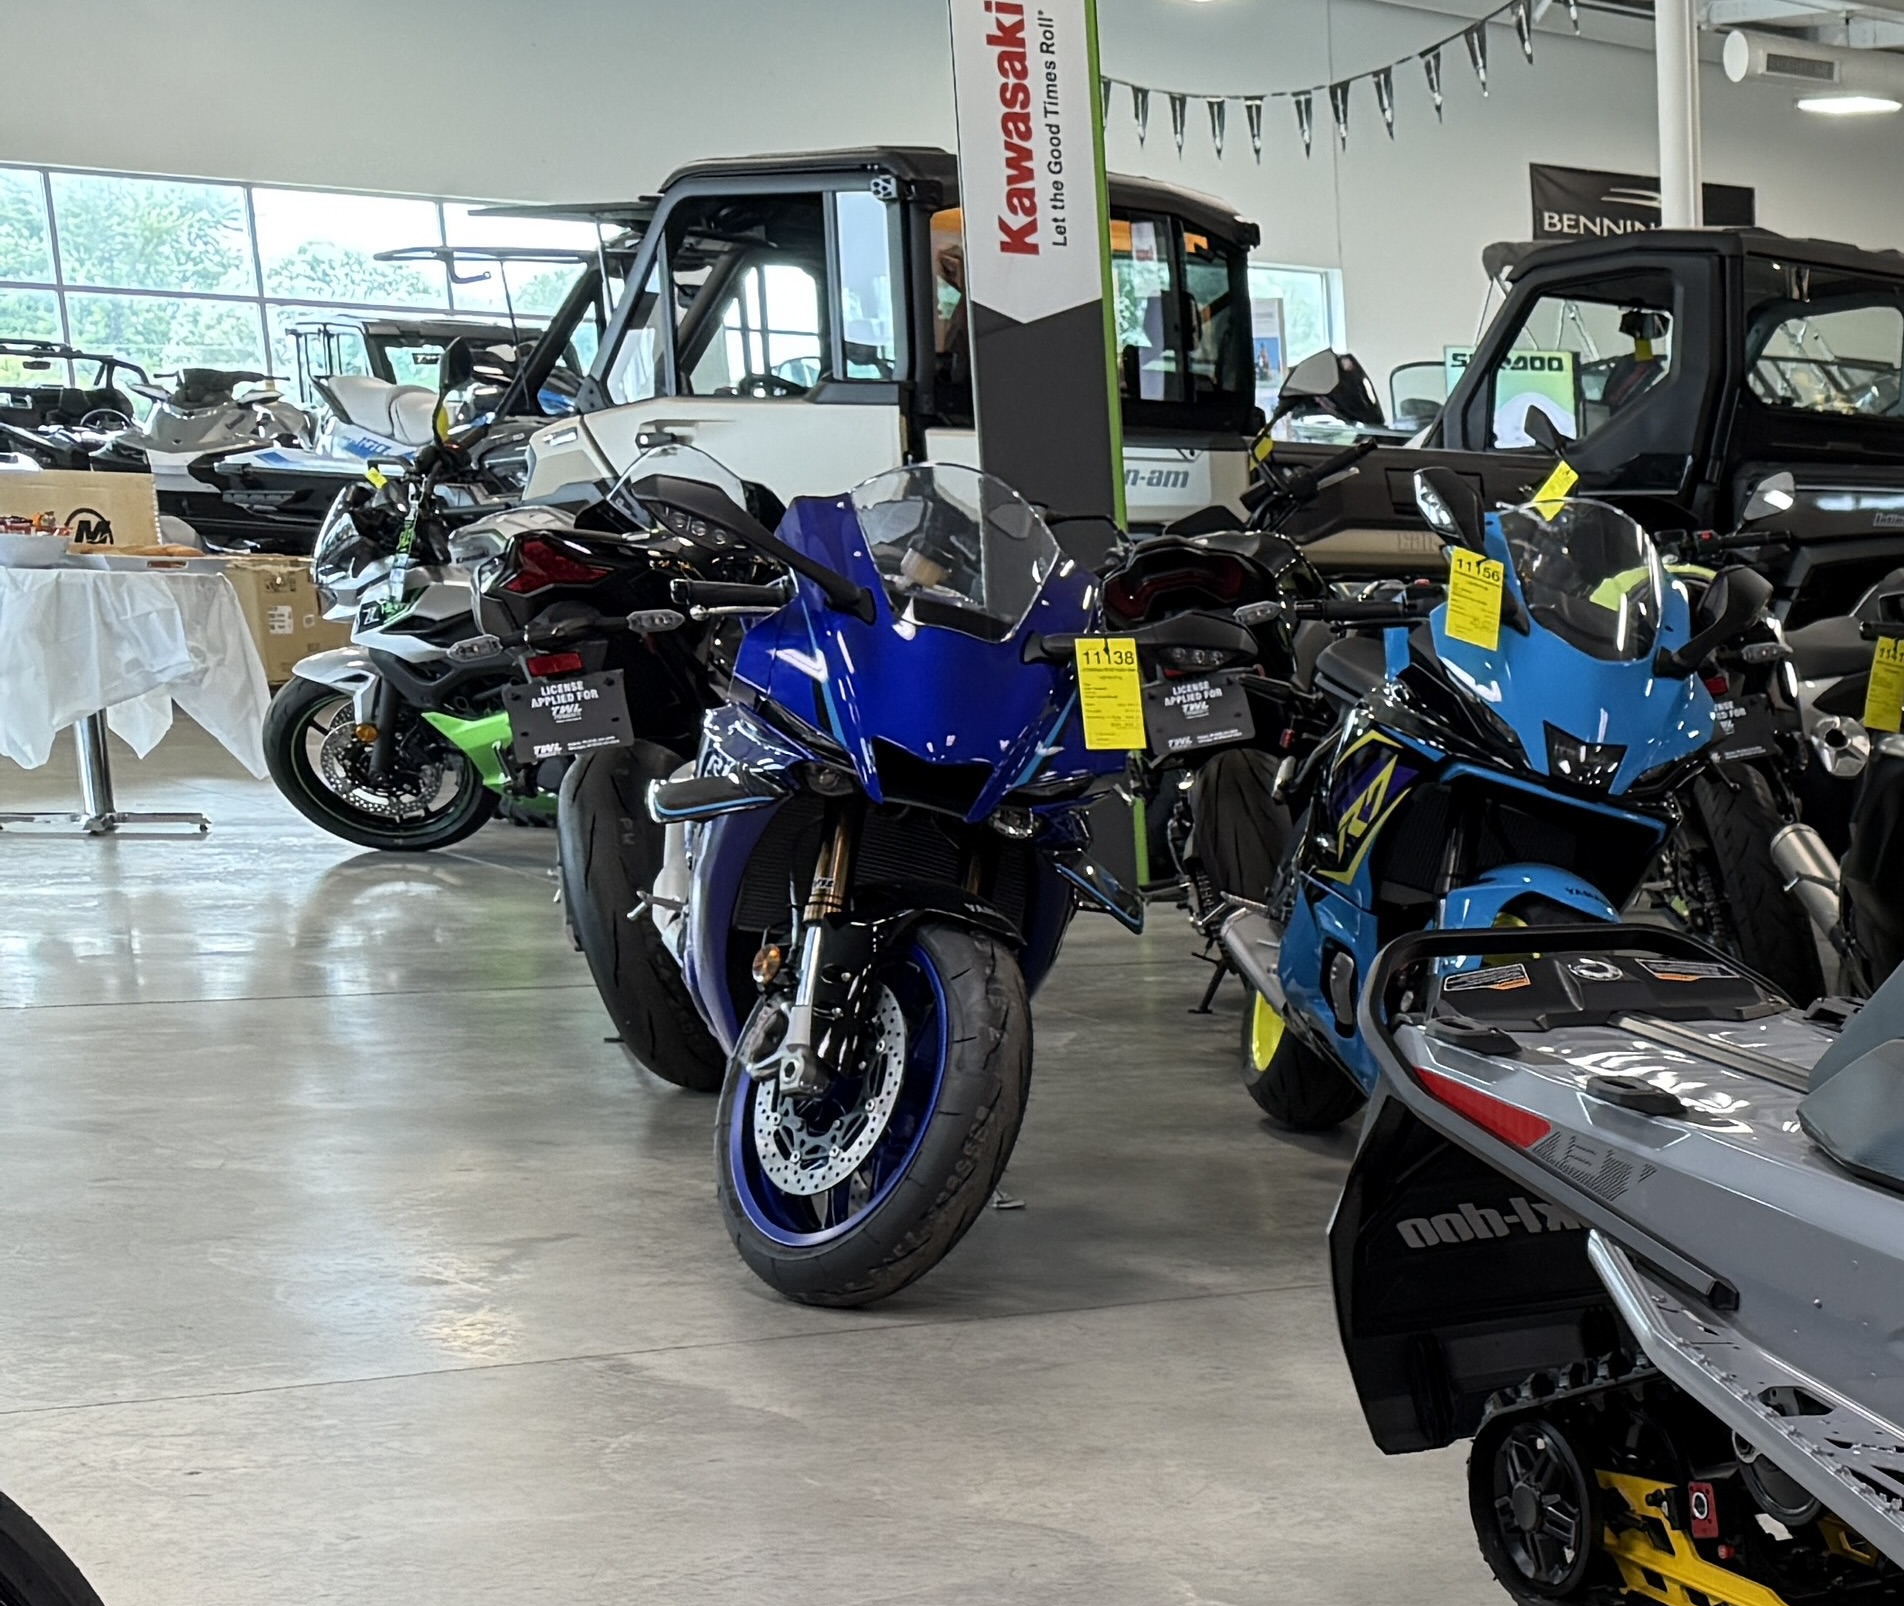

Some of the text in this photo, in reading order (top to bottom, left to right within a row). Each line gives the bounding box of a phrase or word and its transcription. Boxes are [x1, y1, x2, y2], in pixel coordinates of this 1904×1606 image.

[1044, 60, 1059, 118] Times
[984, 0, 1040, 256] Kawasaki
[1047, 124, 1063, 174] Good
[1050, 181, 1065, 212] the
[1052, 217, 1067, 247] Let
[1544, 211, 1656, 236] BENNIN
[1125, 469, 1189, 488] n-am
[1083, 651, 1134, 665] 11138
[541, 680, 584, 696] LICENSE
[1164, 688, 1223, 707] APPLIED FOR
[1172, 681, 1210, 695] LICENSE
[531, 689, 599, 709] APPLIED FOR
[551, 703, 583, 716] TWL
